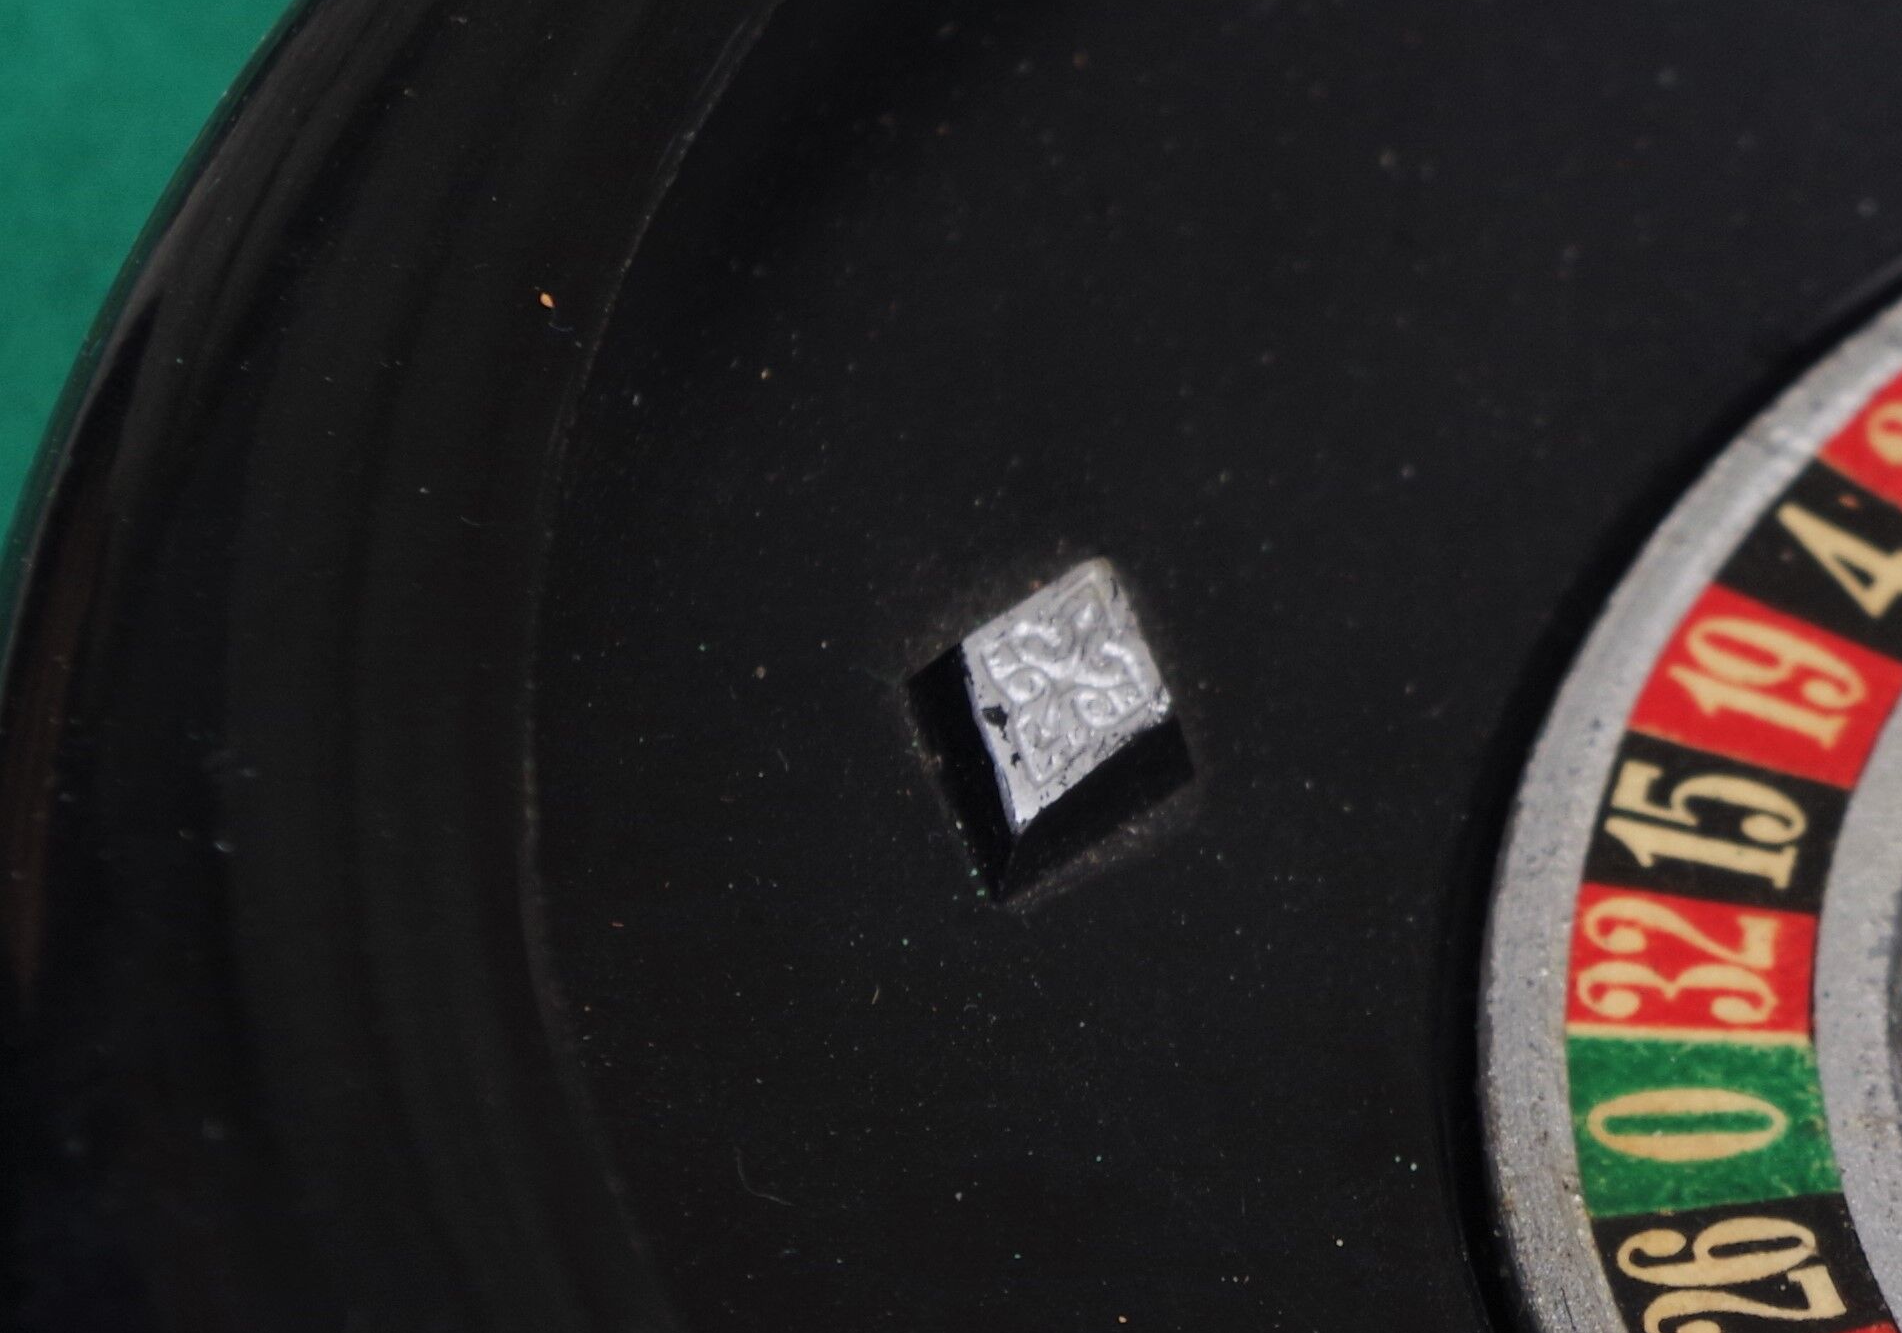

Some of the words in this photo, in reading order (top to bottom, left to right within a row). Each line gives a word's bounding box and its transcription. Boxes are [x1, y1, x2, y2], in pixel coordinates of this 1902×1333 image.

[1670, 615, 1869, 749] 19
[1604, 763, 1807, 888] 15
[1578, 898, 1780, 1023] 32
[1586, 1087, 1787, 1165] 0
